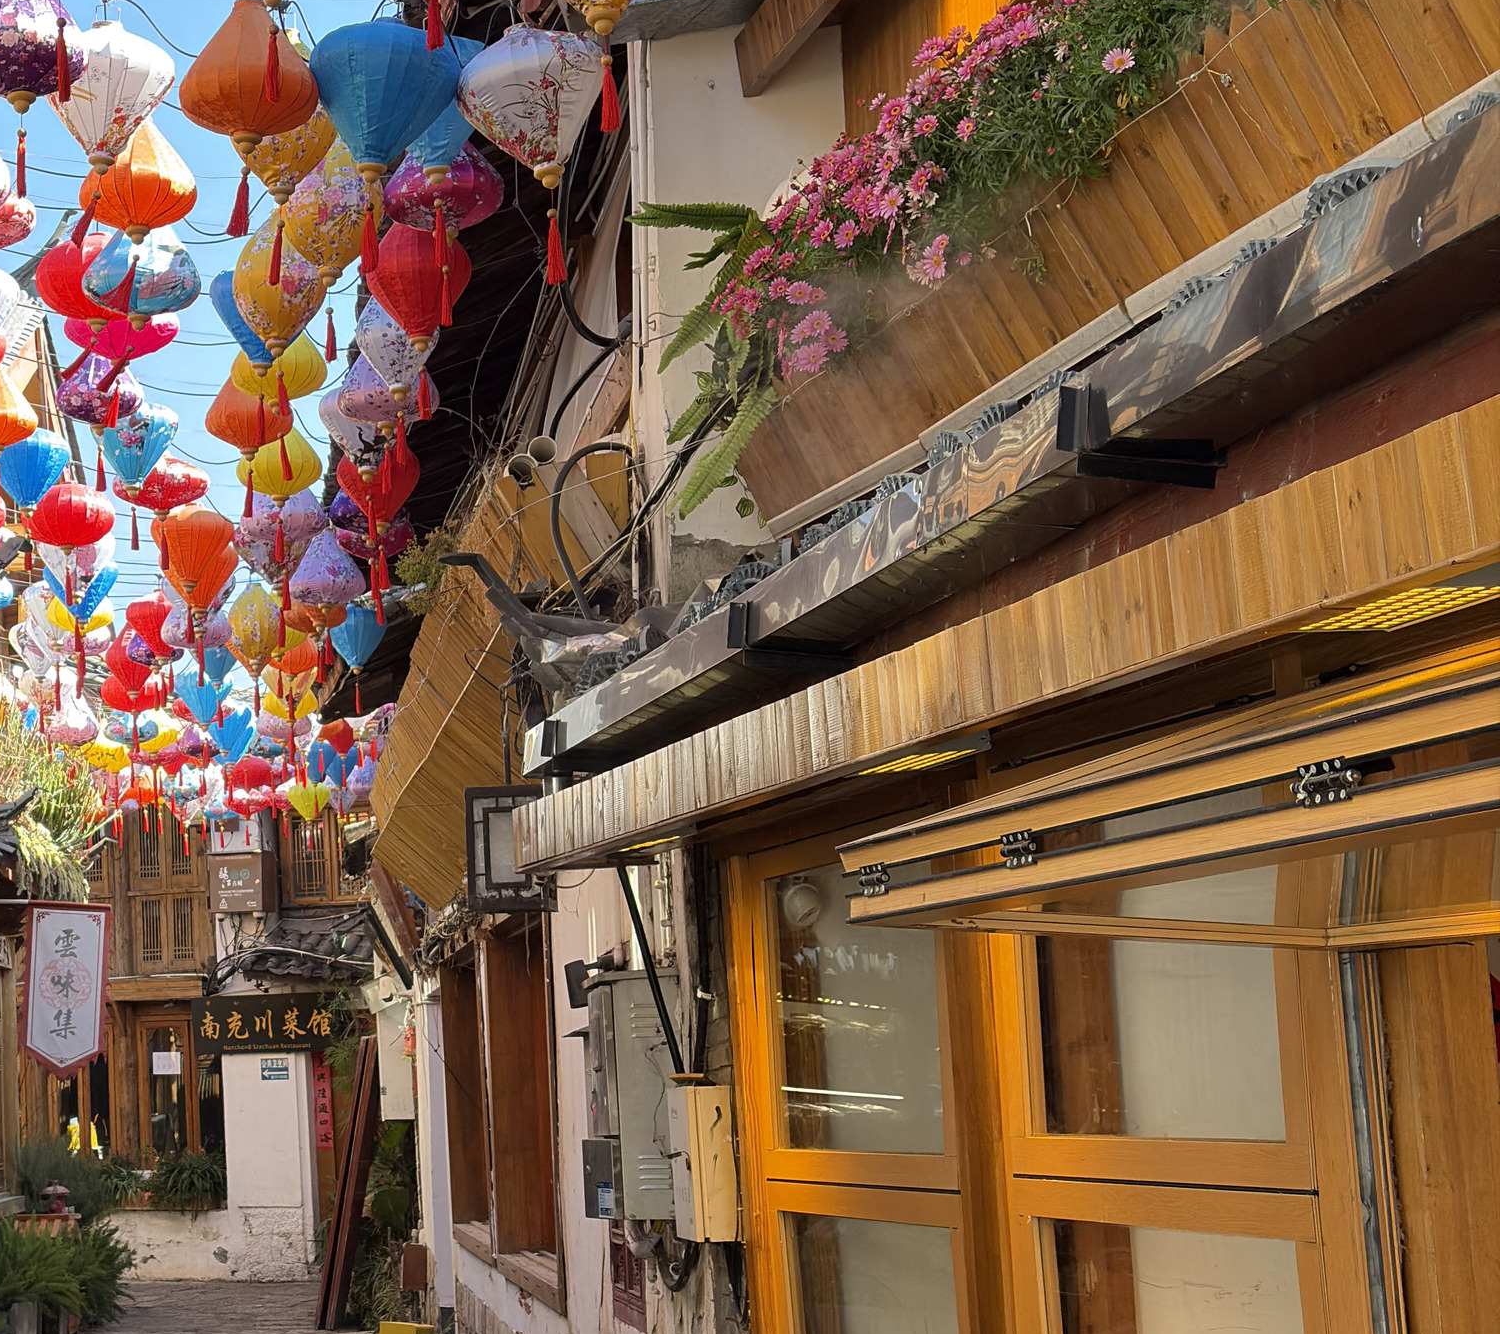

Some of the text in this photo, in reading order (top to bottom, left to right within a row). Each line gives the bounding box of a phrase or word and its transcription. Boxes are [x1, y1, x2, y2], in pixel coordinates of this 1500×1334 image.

[200, 1007, 332, 1040] 南充川菜馆
